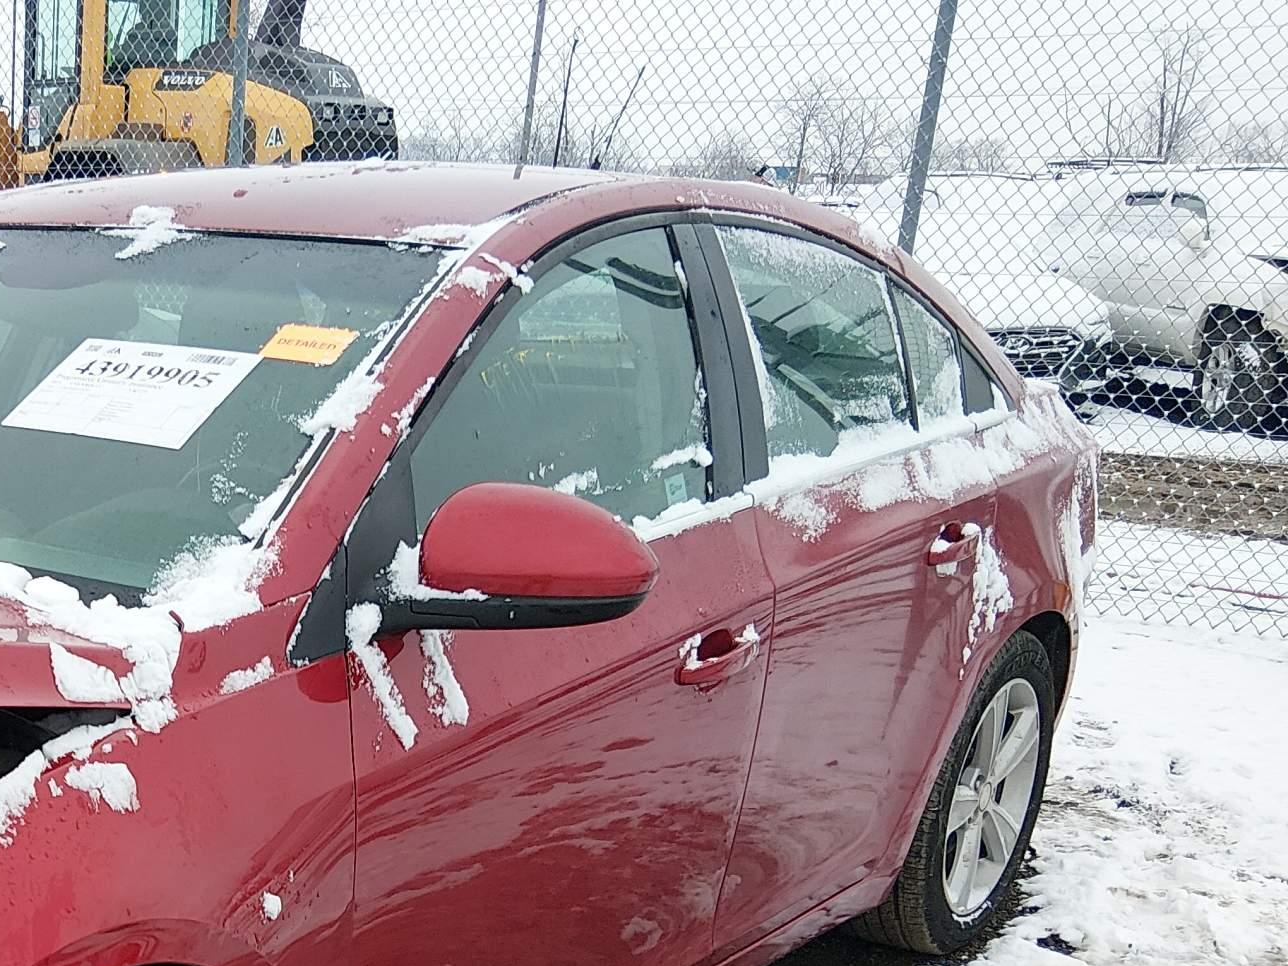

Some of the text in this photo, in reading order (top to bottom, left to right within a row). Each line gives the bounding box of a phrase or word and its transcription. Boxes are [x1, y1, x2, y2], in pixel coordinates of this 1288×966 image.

[163, 74, 205, 86] VOLVO
[277, 338, 337, 350] DETAILED
[75, 359, 220, 389] 43919905
